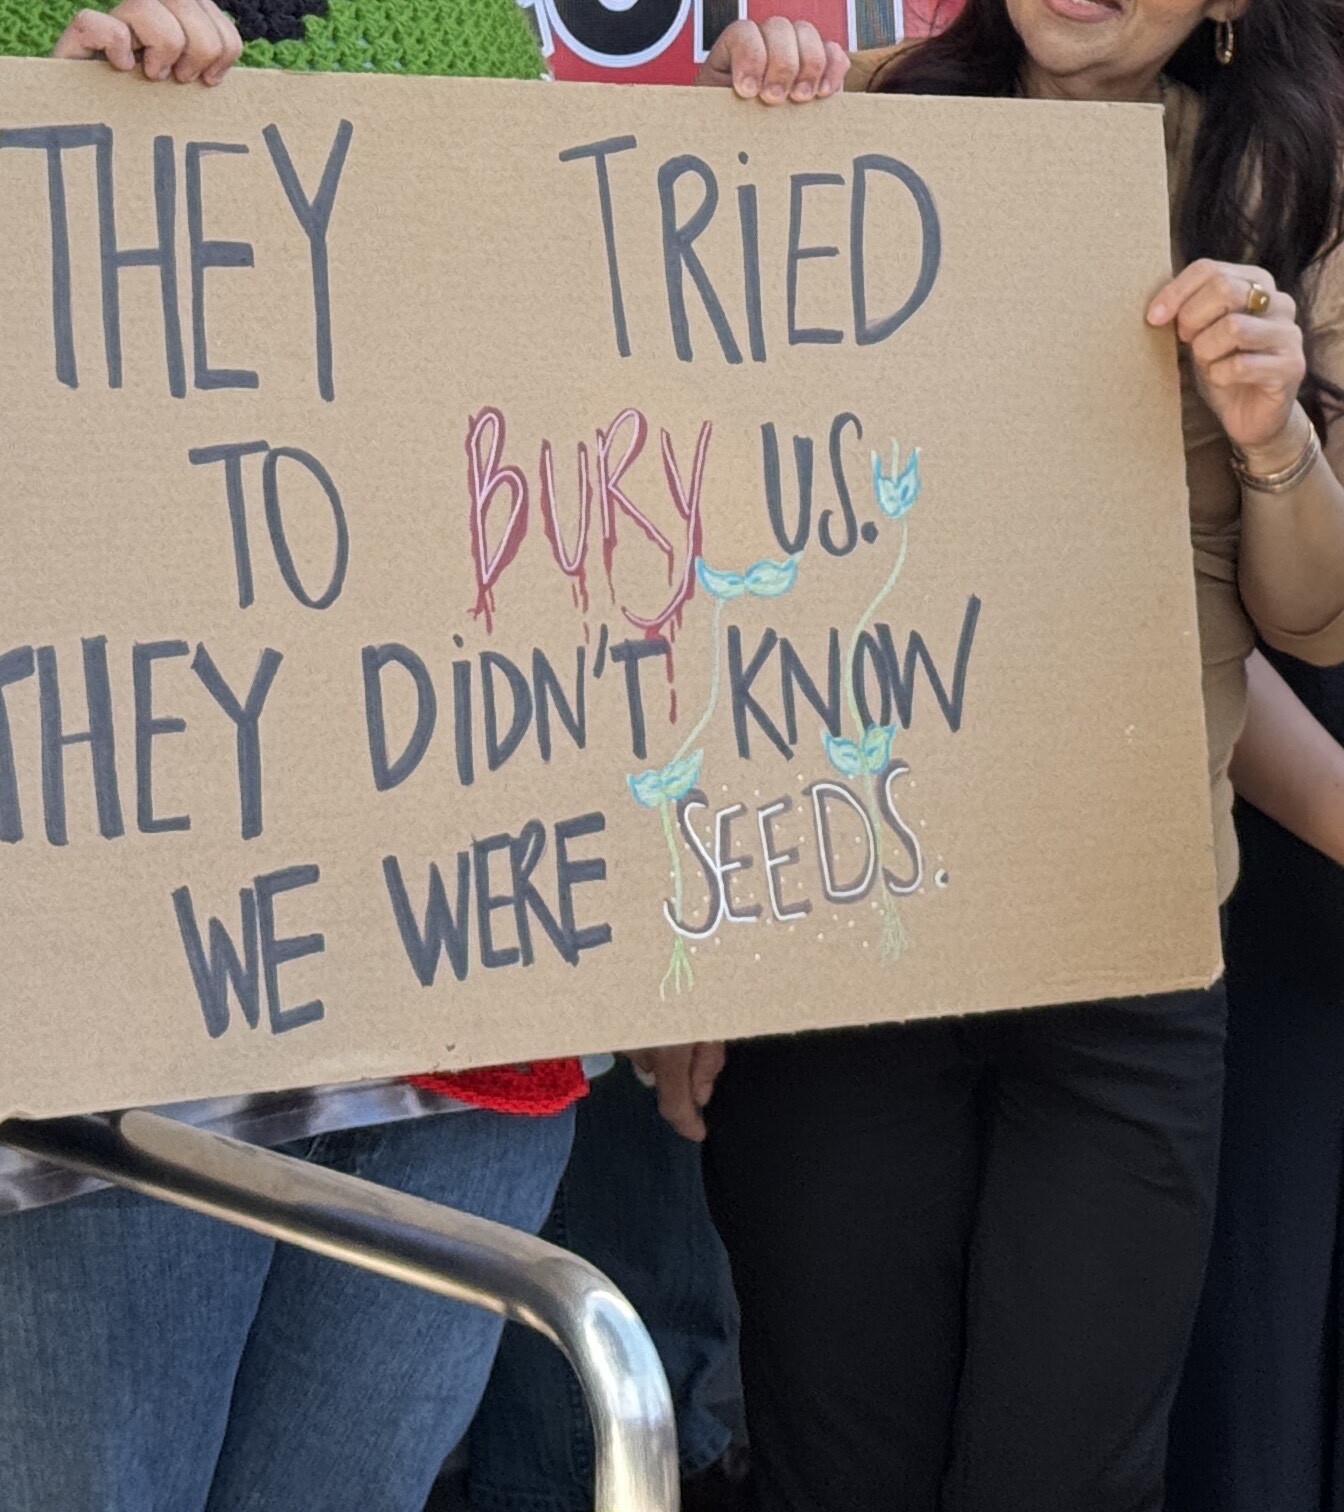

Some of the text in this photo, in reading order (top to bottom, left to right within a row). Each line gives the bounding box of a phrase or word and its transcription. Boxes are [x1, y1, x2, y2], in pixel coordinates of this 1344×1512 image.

[188, 405, 879, 636] TO BURY US.
[727, 594, 981, 760] KNOW
[171, 758, 950, 1038] WE WERE SEEDS.
